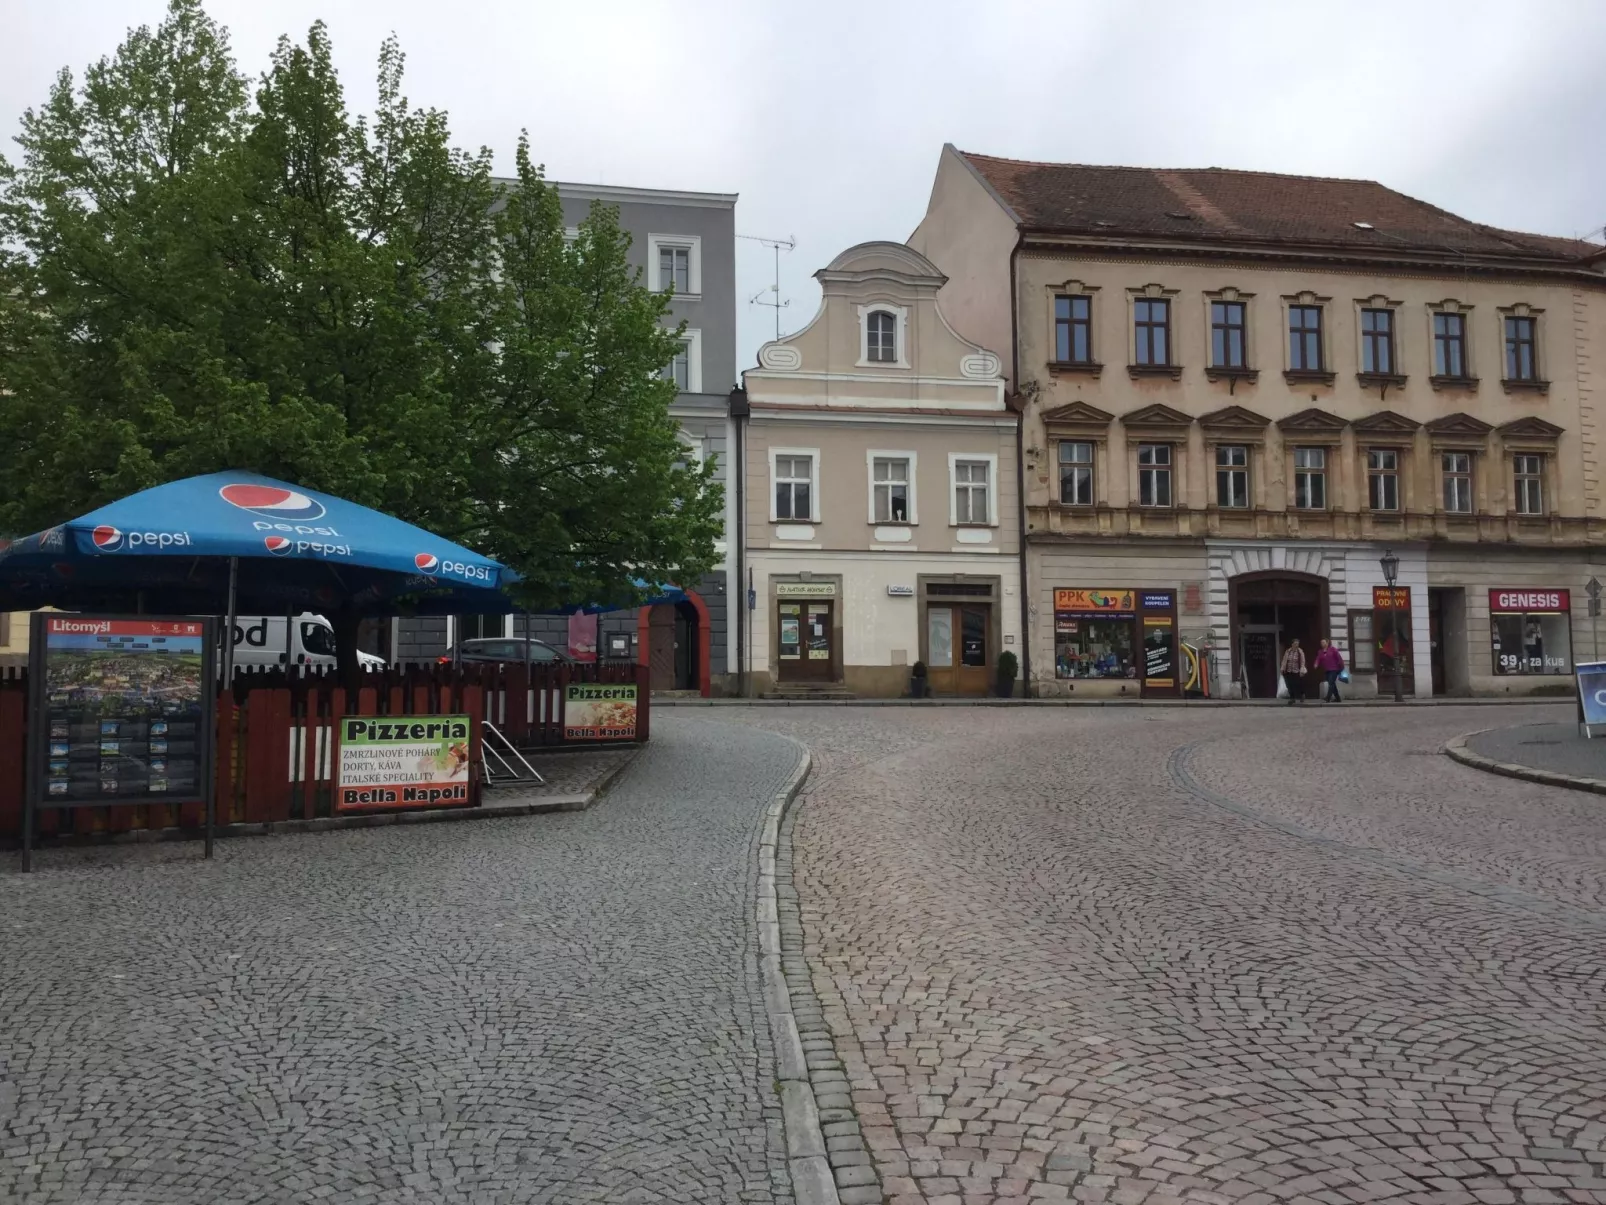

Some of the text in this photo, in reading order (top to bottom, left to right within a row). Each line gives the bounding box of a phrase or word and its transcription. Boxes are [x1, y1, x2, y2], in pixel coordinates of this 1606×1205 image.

[252, 521, 340, 537] pepsi
[129, 531, 191, 549] pepsi
[297, 541, 351, 556] pepsi
[442, 560, 490, 581] pepsi
[1059, 591, 1085, 602] PPK
[1378, 599, 1405, 607] ODVY
[1499, 593, 1560, 608] GENESIS
[53, 620, 111, 635] Litomyšl
[1530, 657, 1542, 667] za
[1545, 655, 1565, 667] kus
[568, 687, 636, 699] Pizzeria
[347, 720, 467, 741] Pizzeria
[566, 727, 635, 738] Bella Napoli
[343, 747, 441, 759] ZMRZLINOVÉ POHÁRY
[343, 760, 402, 772] DORTY, KÁVA
[342, 772, 434, 784] ITALSKÉ SPECIALITY
[343, 784, 467, 804] Bella Napoli
